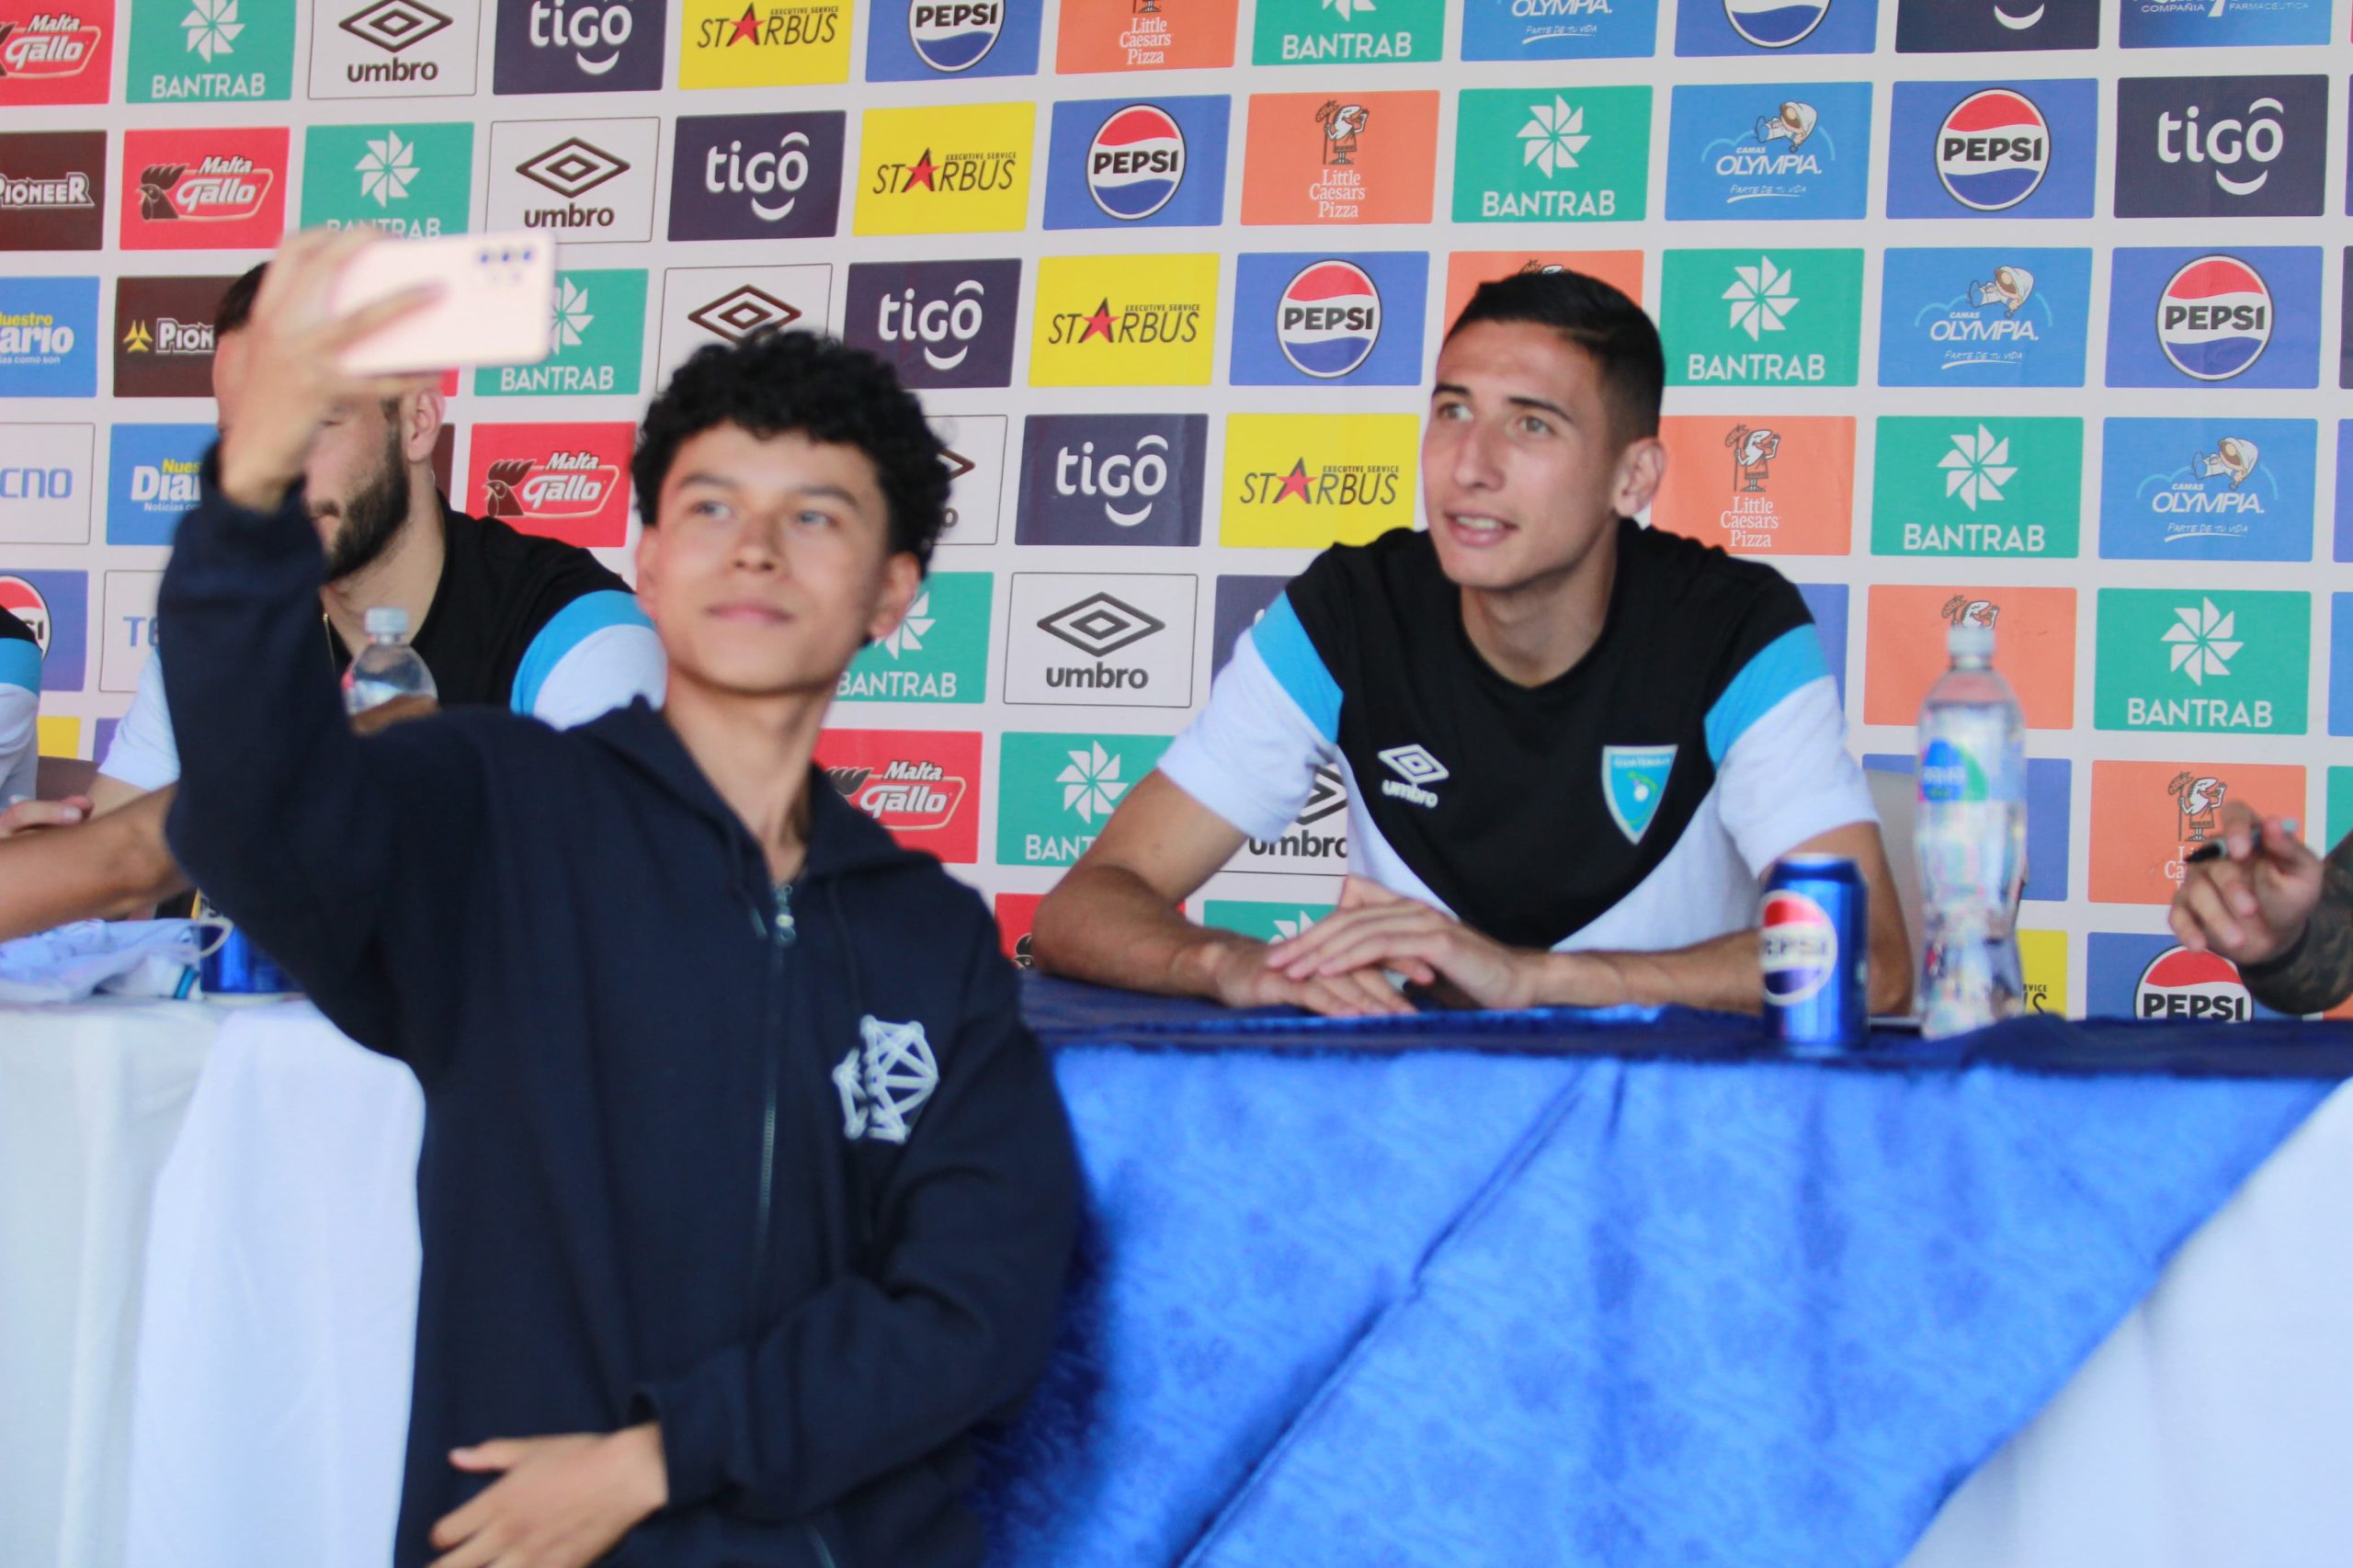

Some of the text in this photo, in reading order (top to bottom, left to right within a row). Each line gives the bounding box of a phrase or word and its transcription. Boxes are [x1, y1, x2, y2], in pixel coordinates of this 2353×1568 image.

[28, 14, 80, 33] Malta
[770, 6, 839, 17] EXECUTIVE SERVICE
[916, 3, 997, 28] PEPSI
[697, 3, 838, 50] STARBUS
[1131, 18, 1166, 34] Little
[5, 35, 85, 71] Gallo
[1120, 32, 1171, 50] Caesars
[1282, 33, 1412, 59] BANTRAB
[1128, 47, 1164, 65] Pizza
[347, 59, 438, 83] umbro
[152, 74, 265, 98] BANTRAB
[946, 153, 1017, 161] EXECUTIVE SERVICE
[1944, 137, 2042, 162] PEPSI
[199, 156, 252, 175] Malta
[872, 148, 1016, 194] STARBUS
[1094, 151, 1177, 175] PEPSI
[1322, 169, 1360, 187] Little
[176, 180, 256, 210] Gallo
[1309, 184, 1365, 201] Caesars
[1483, 190, 1615, 218] BANTRAB
[524, 201, 615, 228] umbro
[1318, 200, 1358, 219] Pizza
[1125, 303, 1200, 312] EXECUTIVE SERVICE
[1284, 307, 1374, 331] PEPSI
[2165, 305, 2265, 330] PEPSI
[1049, 298, 1199, 345] STARBUS
[0, 326, 74, 354] ario
[158, 321, 215, 350] PION
[501, 367, 614, 392] BANTRAB
[1688, 354, 1825, 381] BANTRAB
[162, 459, 200, 473] Nues
[547, 451, 598, 470] Malta
[1323, 465, 1400, 473] EXECUTIVE SERVICE
[523, 476, 602, 506] Gallo
[1240, 458, 1400, 506] STARBUS
[1733, 497, 1774, 515] Little
[1721, 512, 1779, 530] Caesars
[1731, 529, 1772, 548] Pizza
[1904, 523, 2045, 551] BANTRAB
[836, 671, 956, 698] BANTRAB
[1046, 662, 1148, 689] umbro
[2127, 699, 2272, 728] BANTRAB
[883, 761, 943, 781] Malta
[860, 785, 949, 818] Gallo
[1382, 779, 1438, 808] umbro
[1026, 835, 1097, 860] BANT
[2143, 994, 2244, 1021] PEPSI
